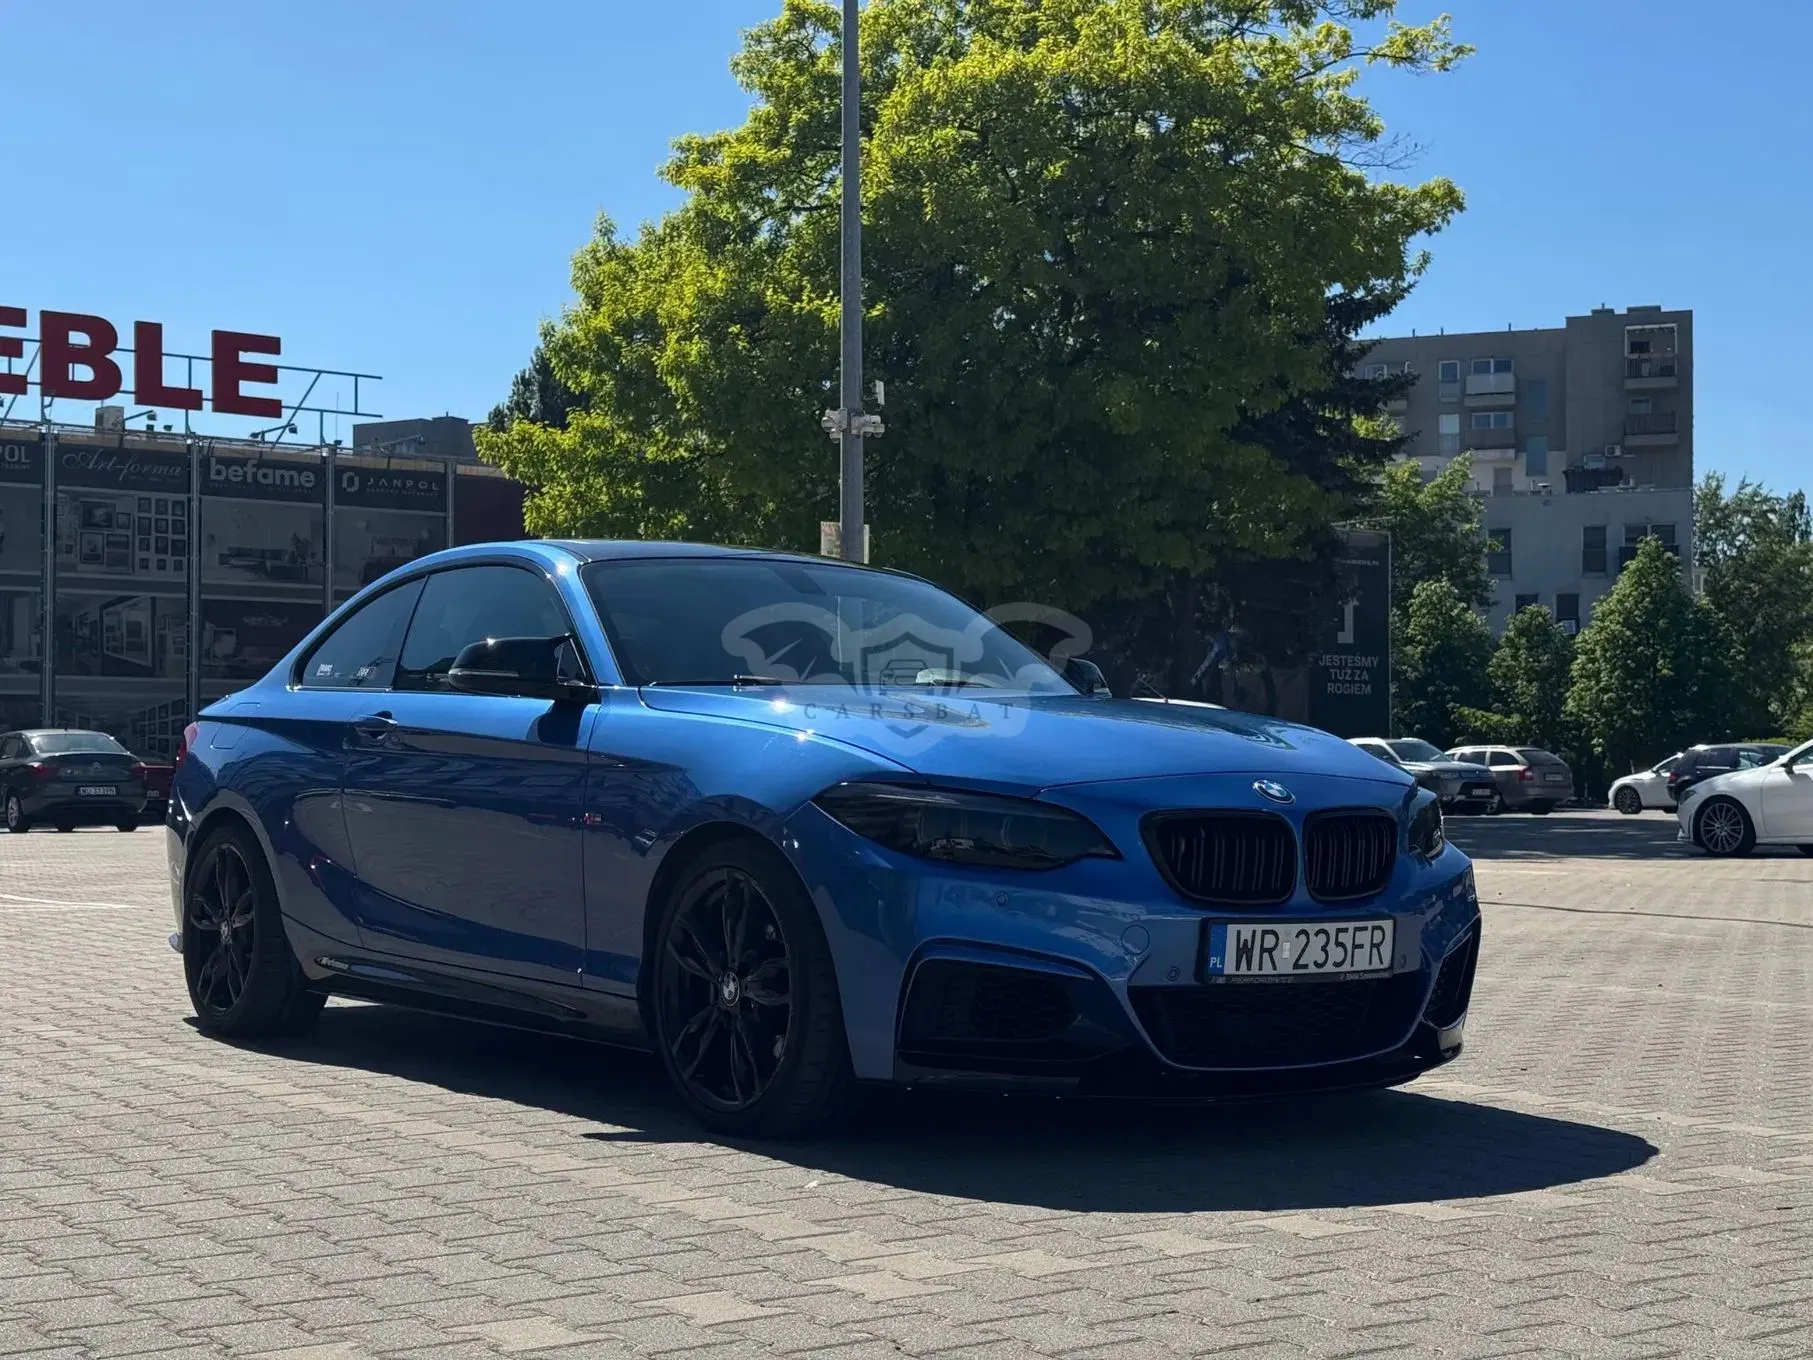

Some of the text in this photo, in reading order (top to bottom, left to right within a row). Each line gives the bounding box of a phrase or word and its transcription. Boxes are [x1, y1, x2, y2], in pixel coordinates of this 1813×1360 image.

[0, 444, 32, 463] OL
[62, 448, 184, 482] Art-forma
[209, 457, 316, 488] befame
[367, 477, 440, 490] JANPOL
[1318, 652, 1379, 668] JESTEŚMY
[1354, 669, 1369, 681] ZA
[1327, 682, 1372, 695] ROGIEM
[1235, 925, 1387, 972] WR 235FR
[1210, 956, 1223, 968] PL
